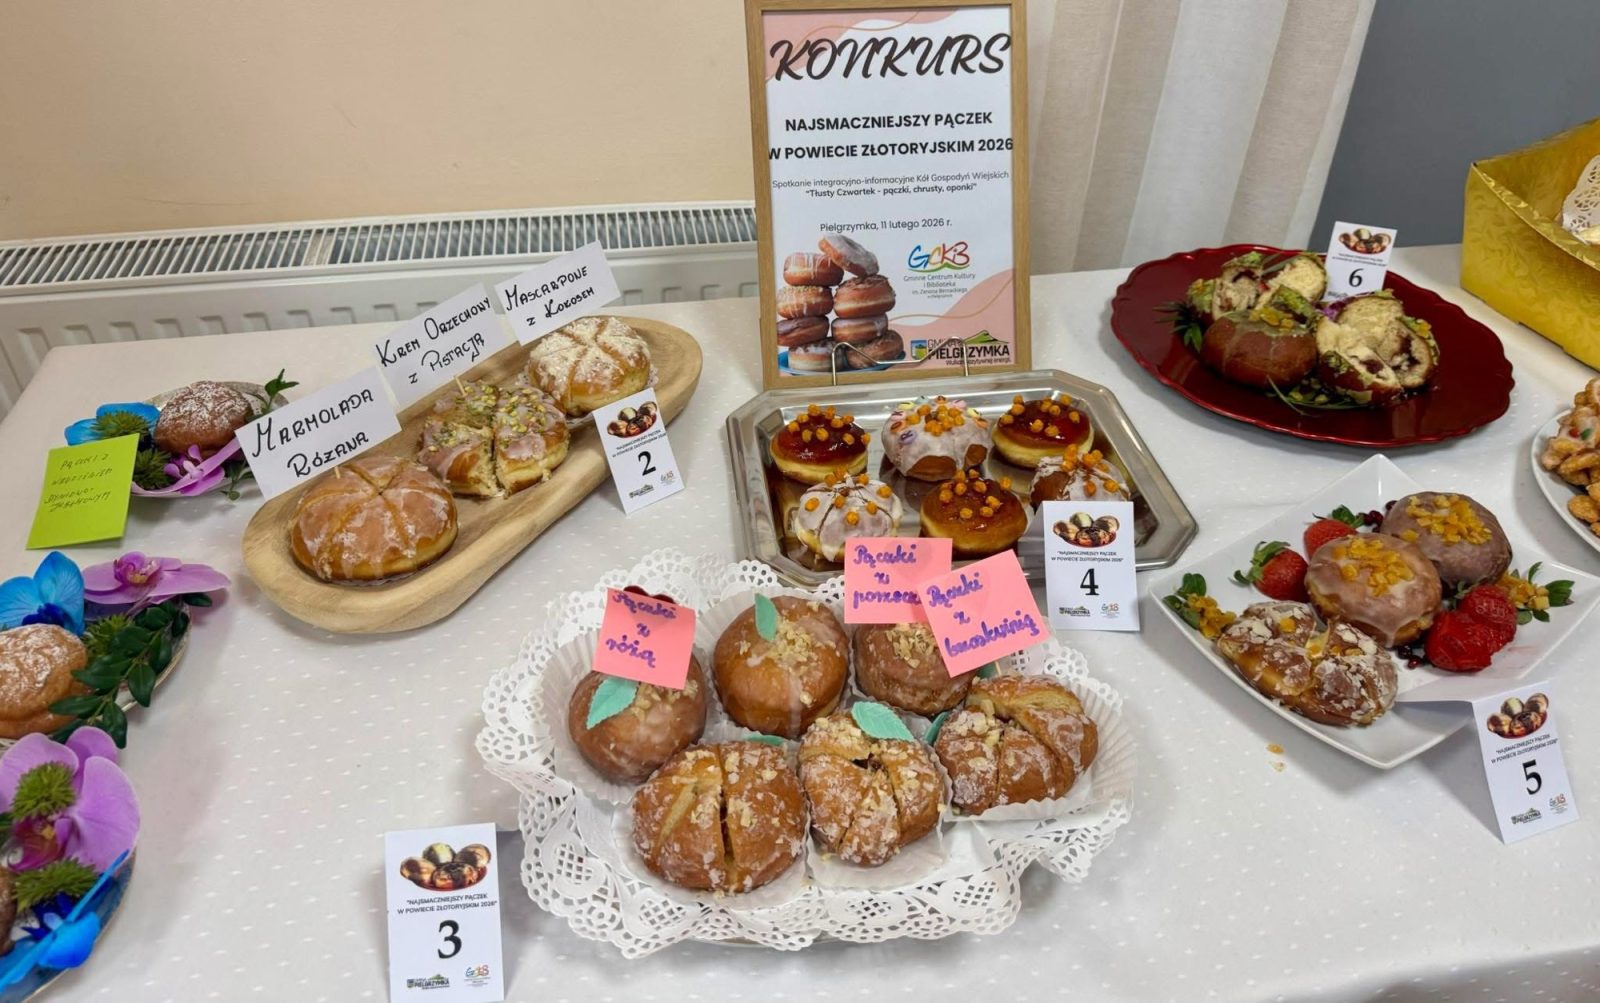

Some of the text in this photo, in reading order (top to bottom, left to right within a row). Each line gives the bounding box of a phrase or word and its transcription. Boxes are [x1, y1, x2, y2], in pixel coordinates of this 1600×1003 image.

[770, 33, 1011, 81] KONKURS
[785, 112, 992, 132] NAJSMACZNIEJSZY PĄCZEK
[768, 138, 1013, 160] W POWIECIE ZŁOTORYJSKIM 2026
[772, 170, 1009, 189] Spotkanie integracyjno-informacyjne Kół Gospodyń Wiejskich
[837, 187, 875, 197] Czwartek
[883, 185, 911, 196] pączki,
[913, 184, 944, 194] chrusty,
[820, 218, 952, 233] Pielgrzymka, 11 lutego 2026 r.
[504, 265, 588, 311] MASCARPONE
[1349, 268, 1364, 288] 6
[544, 286, 595, 318] KOKOSEM
[375, 338, 421, 367] KREM
[252, 389, 374, 457] MARMOLADA
[638, 451, 656, 476] 2
[1079, 568, 1100, 596] 4
[1522, 758, 1542, 795] 5
[437, 919, 462, 959] 3
